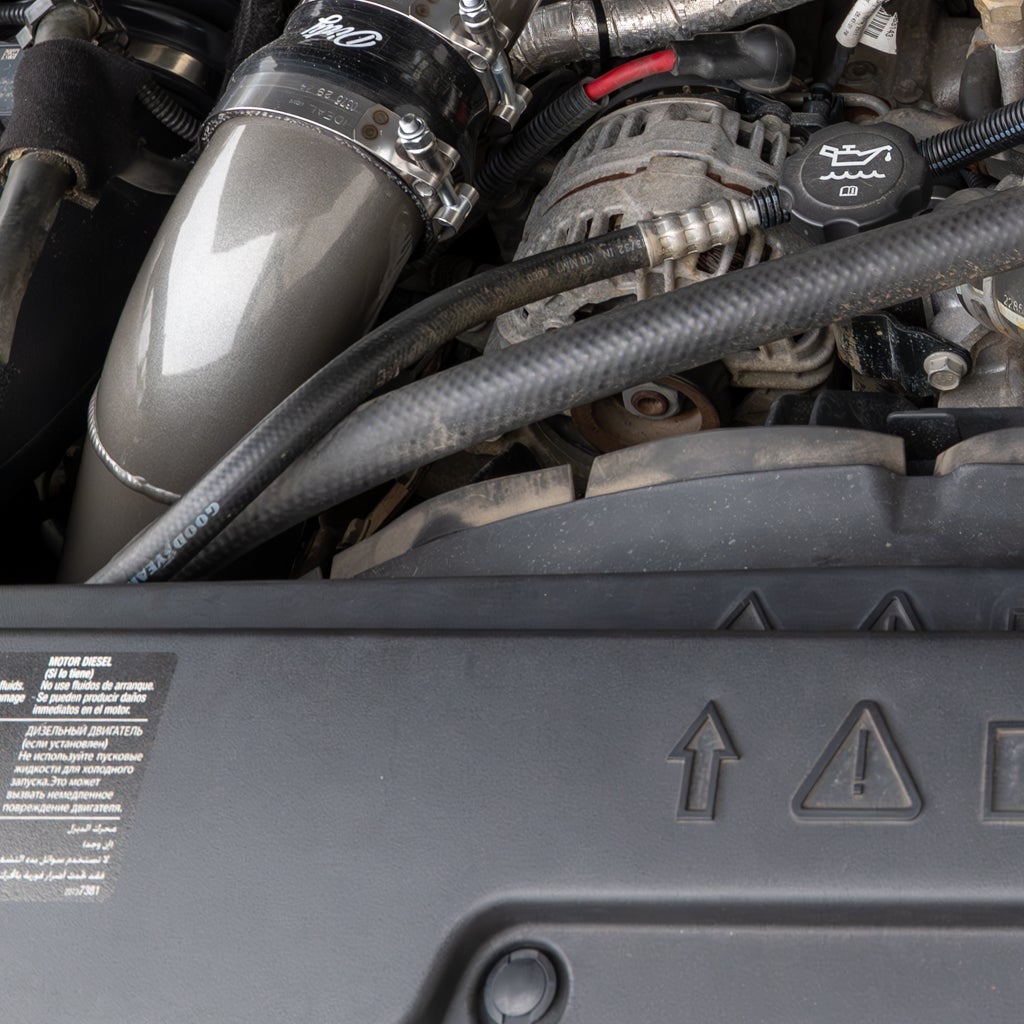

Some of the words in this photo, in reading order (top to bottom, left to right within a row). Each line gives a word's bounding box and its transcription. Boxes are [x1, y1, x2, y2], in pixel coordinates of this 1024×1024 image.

[48, 656, 80, 667] MOTOR
[82, 656, 113, 667] DIESEL
[44, 668, 58, 680] (Si
[58, 668, 68, 679] lo
[68, 668, 94, 680] tiene)
[40, 680, 53, 691] No
[54, 682, 70, 691] use
[71, 680, 100, 691] fluidos
[101, 680, 113, 691] de
[114, 681, 155, 693] arranque.
[49, 692, 81, 704] pueden
[82, 692, 118, 704] producir
[119, 692, 147, 703] daños
[32, 704, 80, 715] inmediatos
[81, 706, 93, 715] en
[93, 704, 103, 715] el
[104, 705, 131, 715] motor.
[25, 724, 87, 737] ДИЗЕЛЬНЫЙ
[87, 725, 144, 737] ДВИГАТЕЛЬ
[22, 738, 49, 750] (если
[49, 738, 109, 750] установлен)
[18, 751, 31, 762] Не
[33, 751, 95, 763] используйте
[96, 752, 144, 763] пусковые
[14, 764, 62, 775] жидкости
[61, 765, 81, 775] для
[81, 764, 135, 775] холодного
